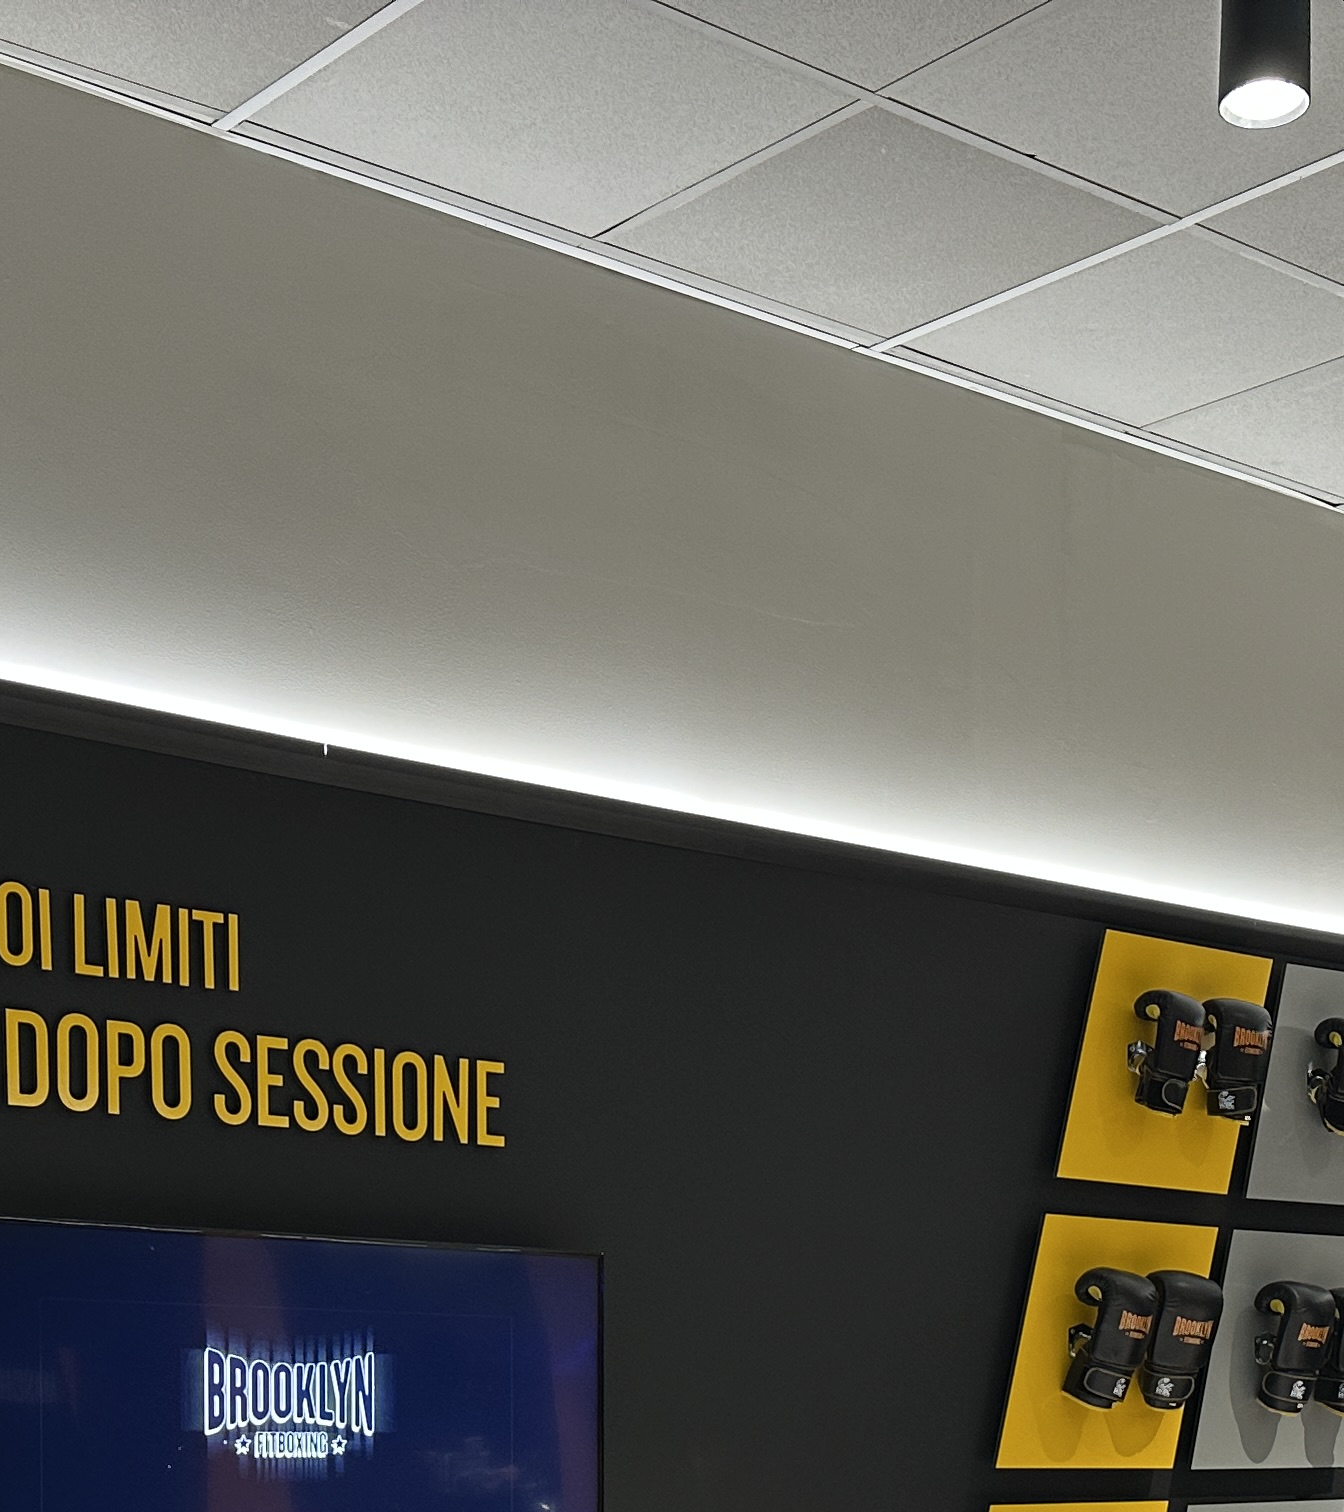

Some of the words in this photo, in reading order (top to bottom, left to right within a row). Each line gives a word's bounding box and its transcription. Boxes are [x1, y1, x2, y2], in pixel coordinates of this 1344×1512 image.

[74, 894, 239, 991] LIMITI
[6, 1008, 191, 1119] DOPO
[214, 1031, 505, 1147] SESSIONE
[204, 1347, 374, 1436] BROOKLYN
[254, 1431, 328, 1458] FITBOXING
